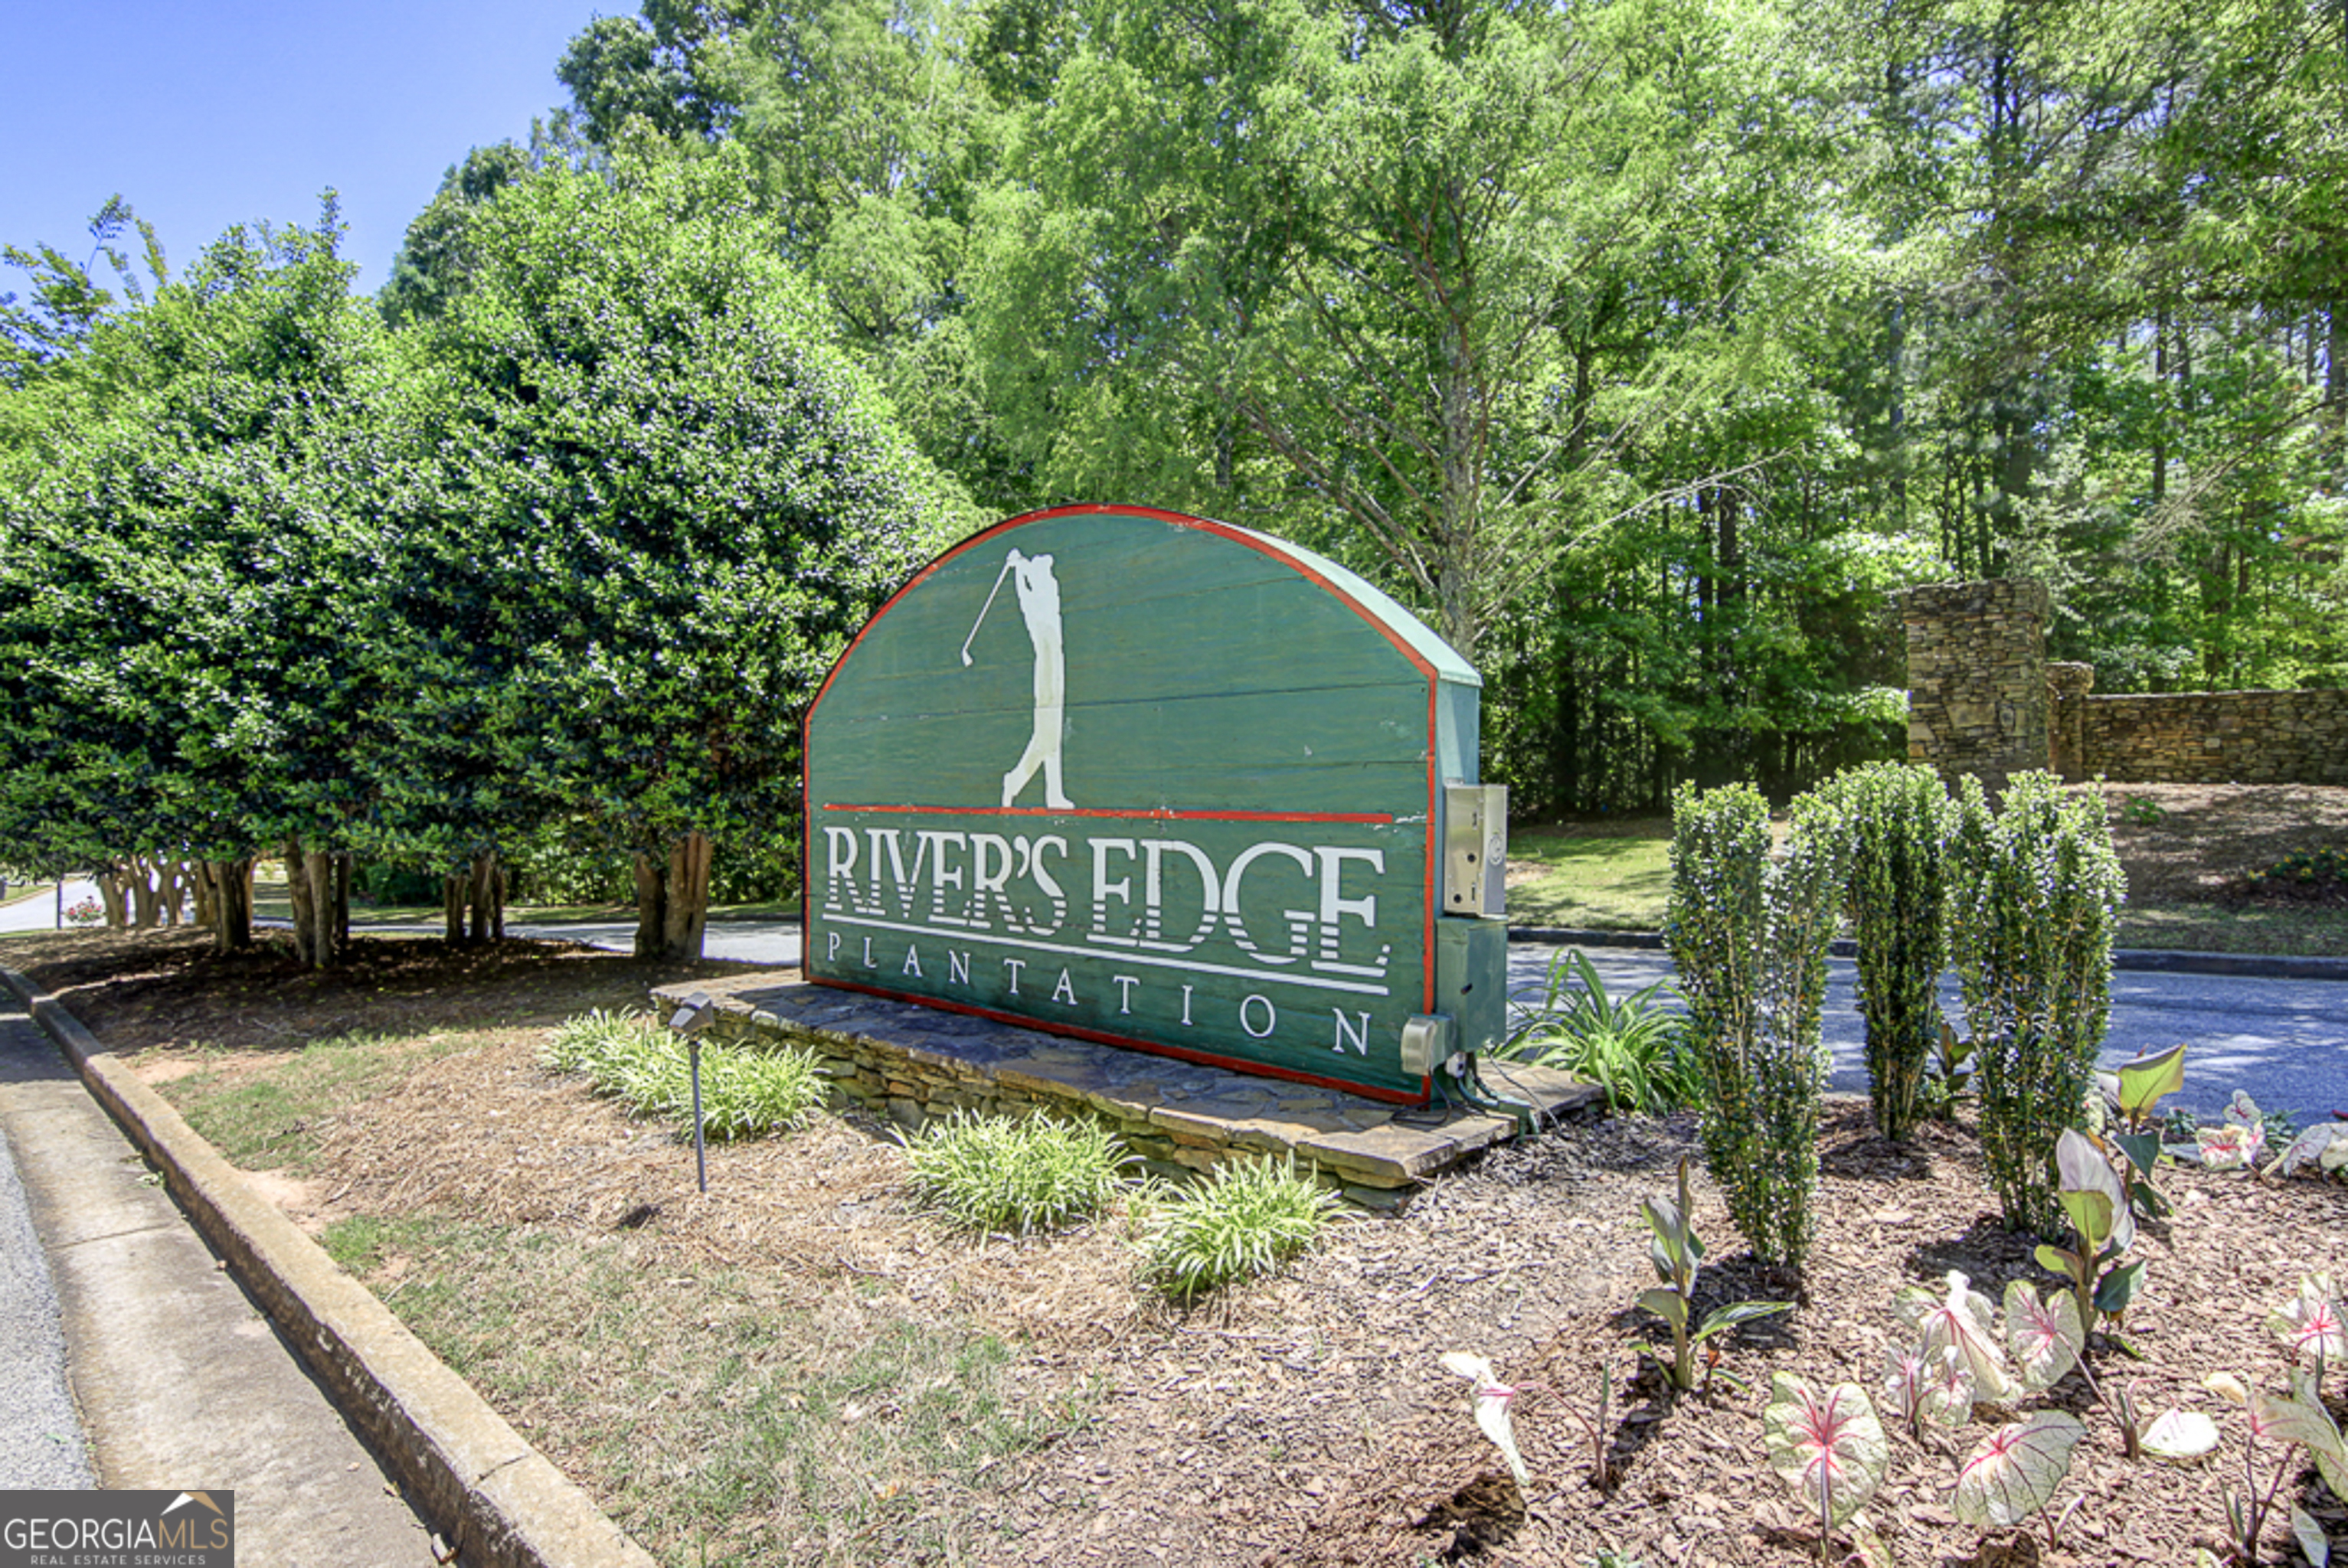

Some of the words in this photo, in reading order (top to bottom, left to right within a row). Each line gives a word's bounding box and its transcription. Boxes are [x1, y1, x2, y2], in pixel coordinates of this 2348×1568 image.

[822, 826, 1068, 936] RIVER'S
[1086, 838, 1391, 977] EDGE
[827, 932, 1371, 1057] PLANTATION
